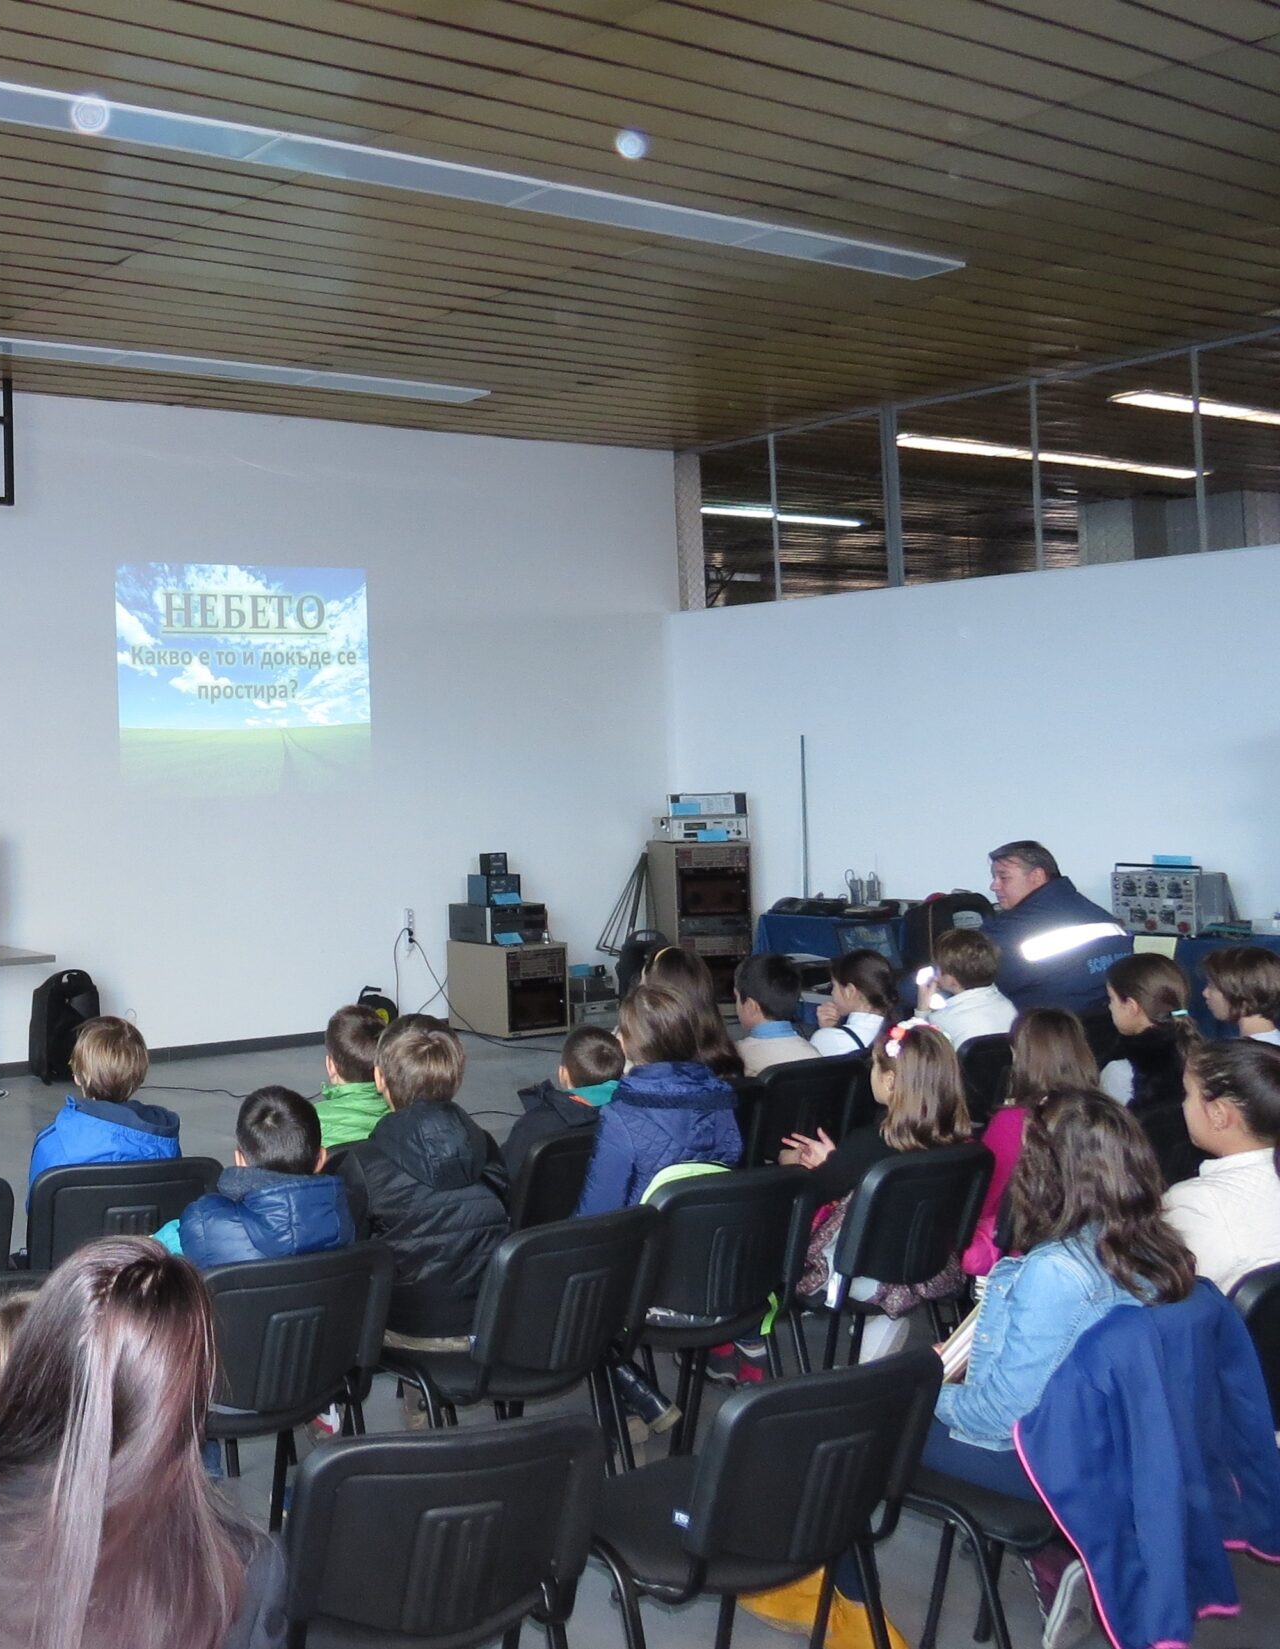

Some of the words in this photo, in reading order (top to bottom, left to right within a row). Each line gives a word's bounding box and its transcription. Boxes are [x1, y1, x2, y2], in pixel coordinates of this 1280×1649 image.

[162, 592, 326, 630] НЕБЕТО
[131, 647, 193, 666] Какво
[198, 650, 210, 666] е
[216, 651, 237, 666] то
[243, 651, 255, 666] и
[261, 650, 332, 669] докъде
[337, 650, 357, 666] се
[197, 680, 299, 704] простира?
